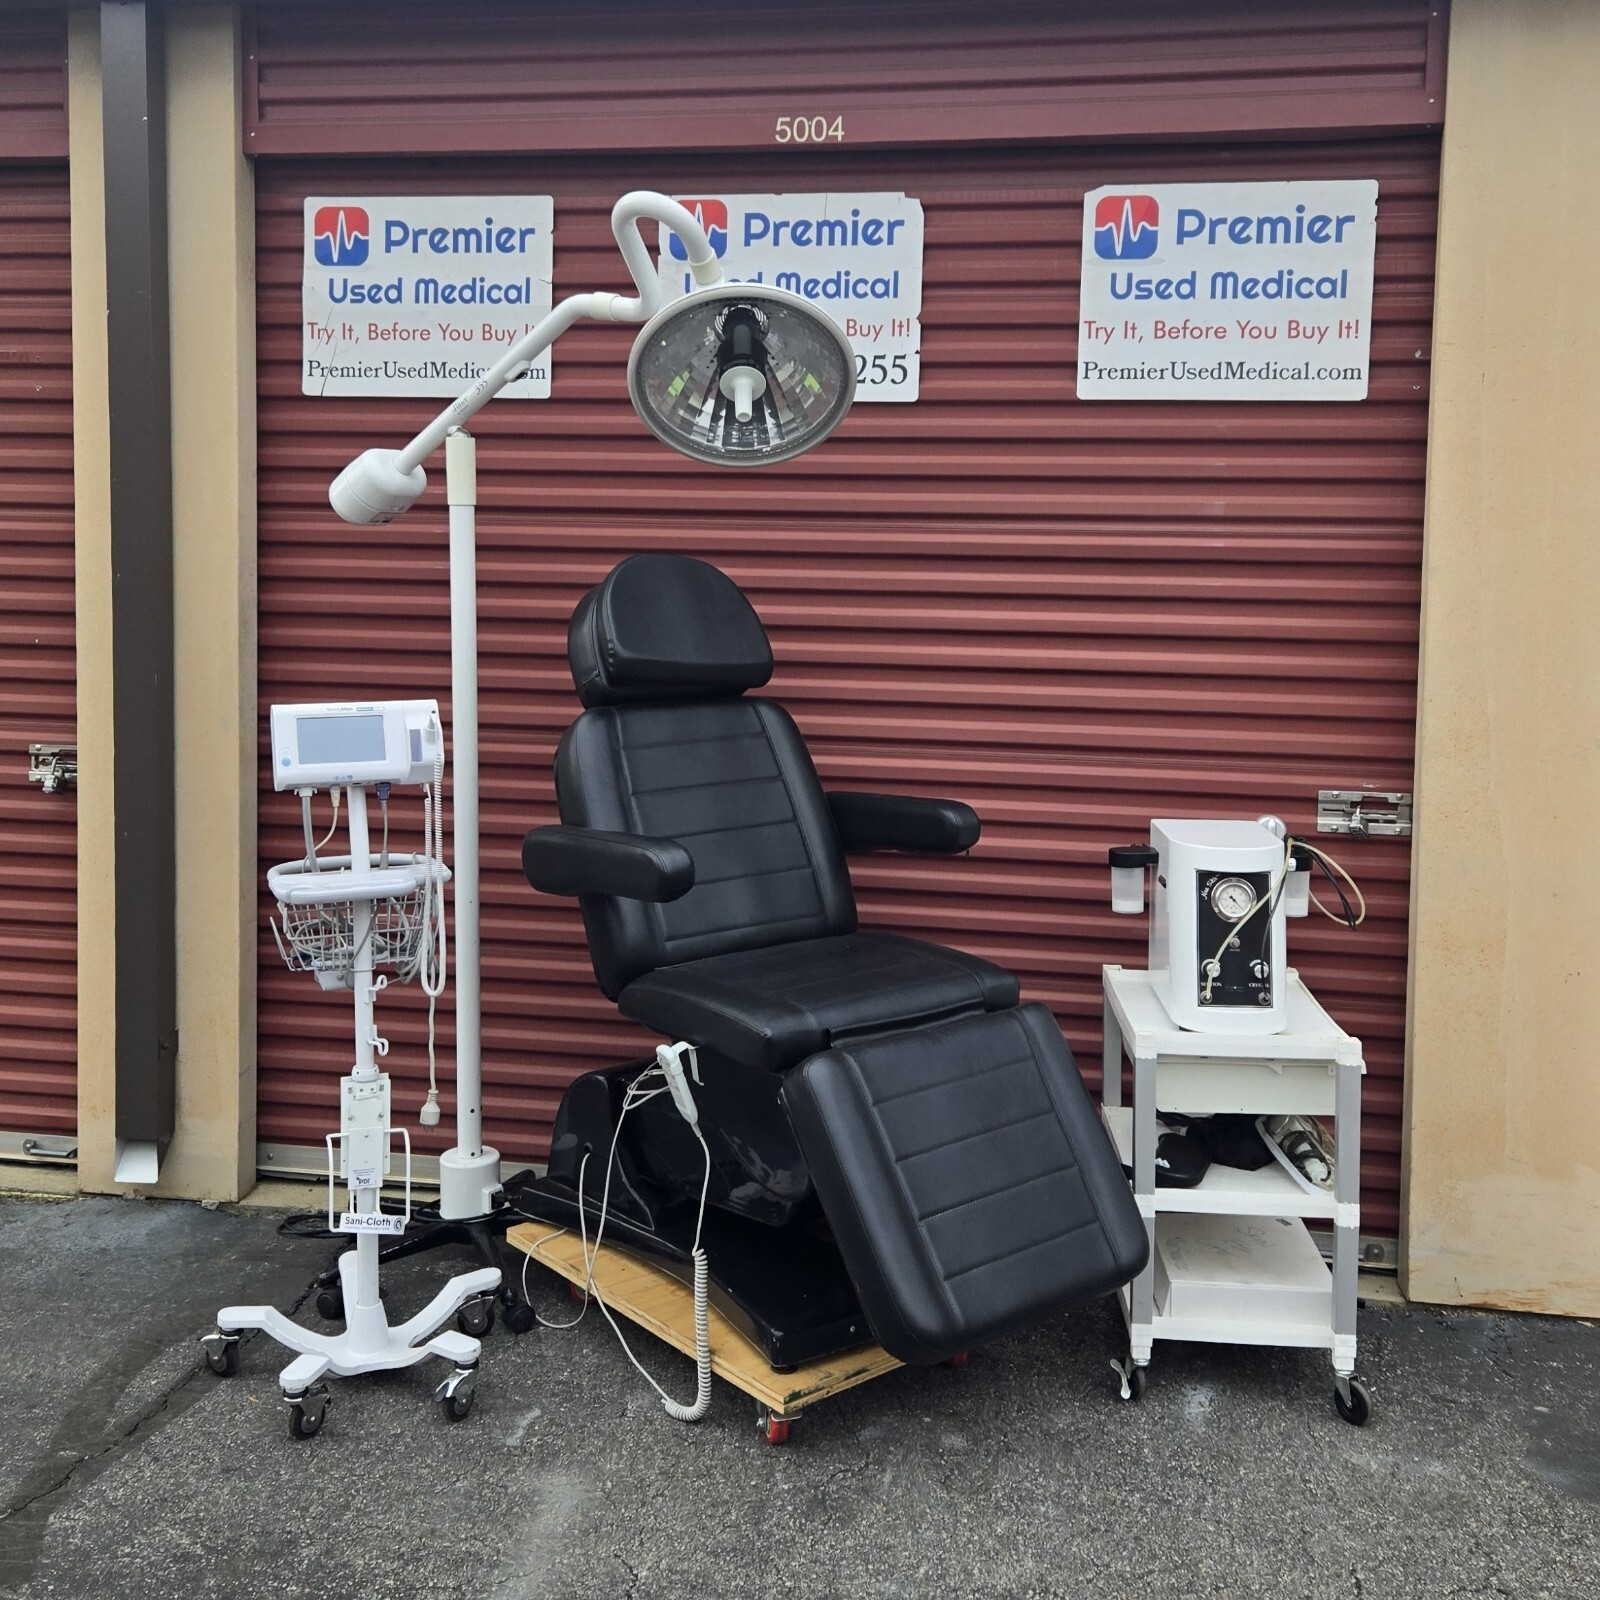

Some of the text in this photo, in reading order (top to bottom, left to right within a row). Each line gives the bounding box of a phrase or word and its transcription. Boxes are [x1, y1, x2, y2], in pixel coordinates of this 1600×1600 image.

[775, 116, 845, 142] 5004
[385, 217, 536, 254] Premier
[743, 208, 905, 247] Premier
[1176, 204, 1356, 246] Premier
[328, 276, 531, 304] Used Medical
[776, 270, 899, 299] Medical
[1110, 269, 1348, 300] Used Medical
[307, 322, 335, 345] Try
[341, 322, 360, 344] It,
[368, 321, 431, 341] Before
[438, 322, 473, 342] You
[482, 323, 517, 346] Buy
[846, 318, 911, 342] Buy It!
[1083, 319, 1360, 344] Try It, Before You Buy It!
[1083, 361, 1363, 381] PremierUsedMedical.com
[345, 1216, 391, 1226] Sani-Cloth
